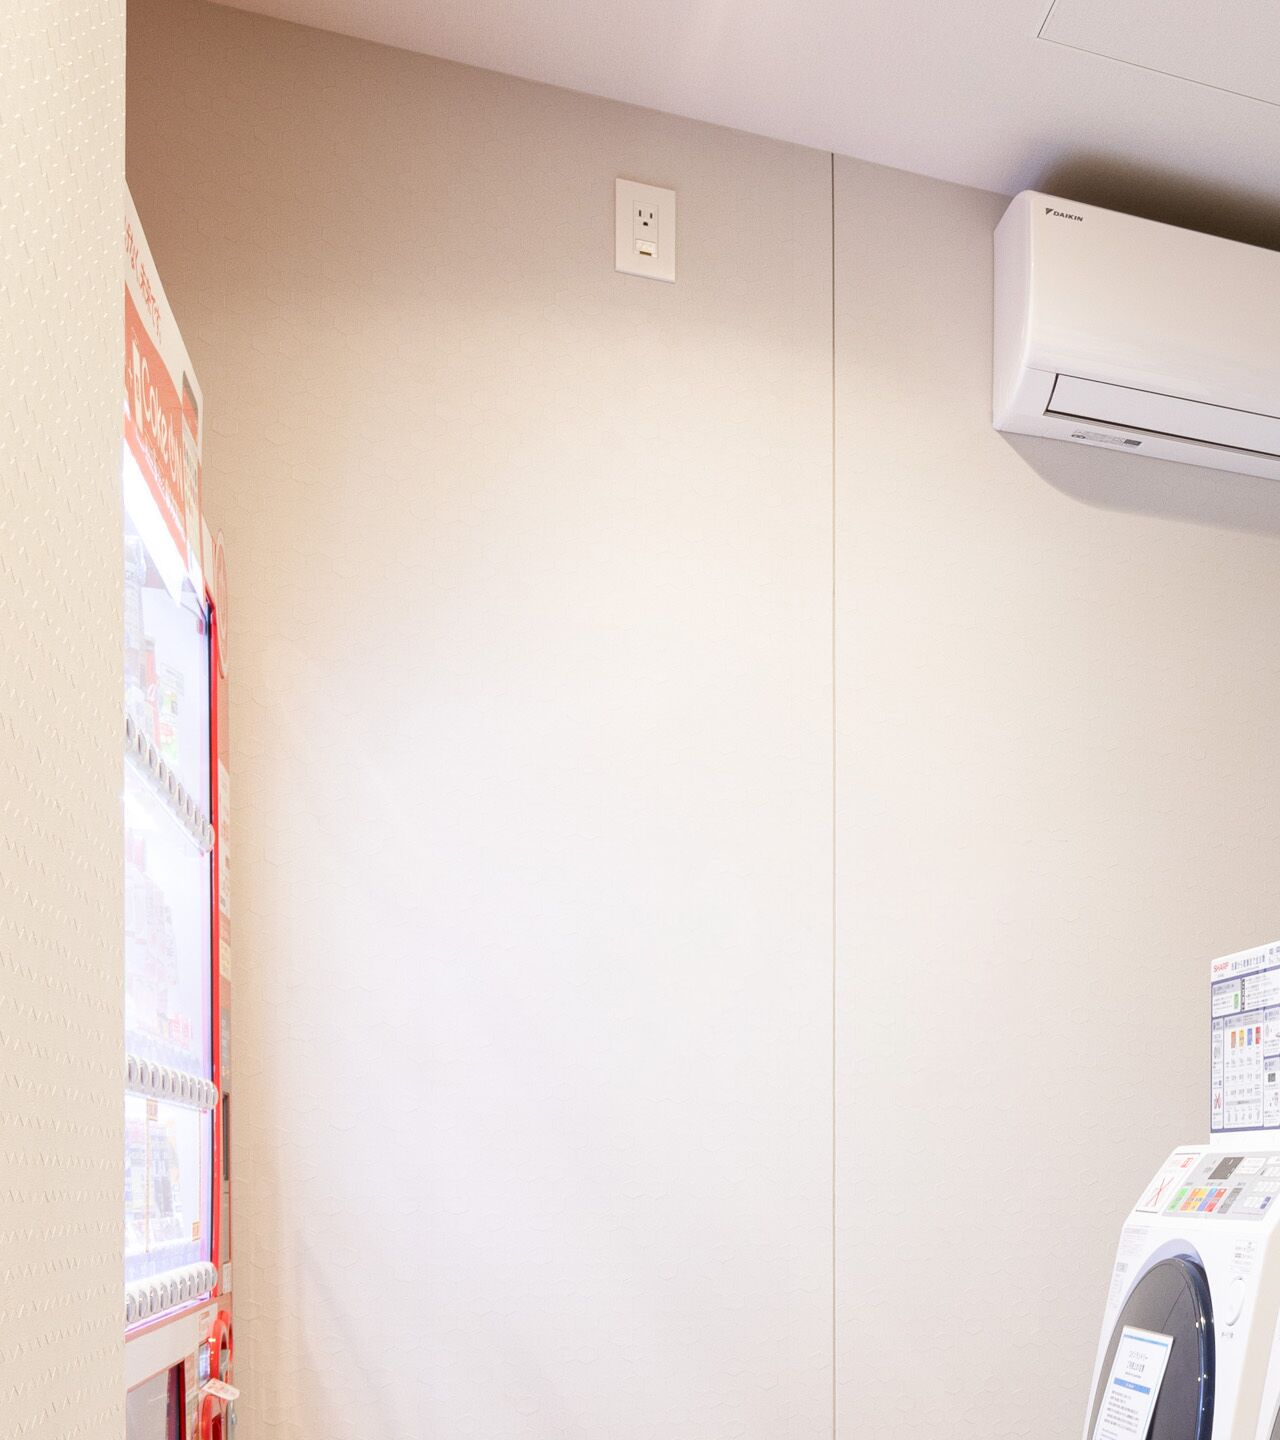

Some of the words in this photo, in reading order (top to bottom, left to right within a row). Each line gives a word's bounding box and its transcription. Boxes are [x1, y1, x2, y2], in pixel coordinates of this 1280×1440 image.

[1053, 211, 1083, 221] DAIKIN
[141, 357, 168, 466] Coke
[1213, 961, 1229, 972] SHARP
